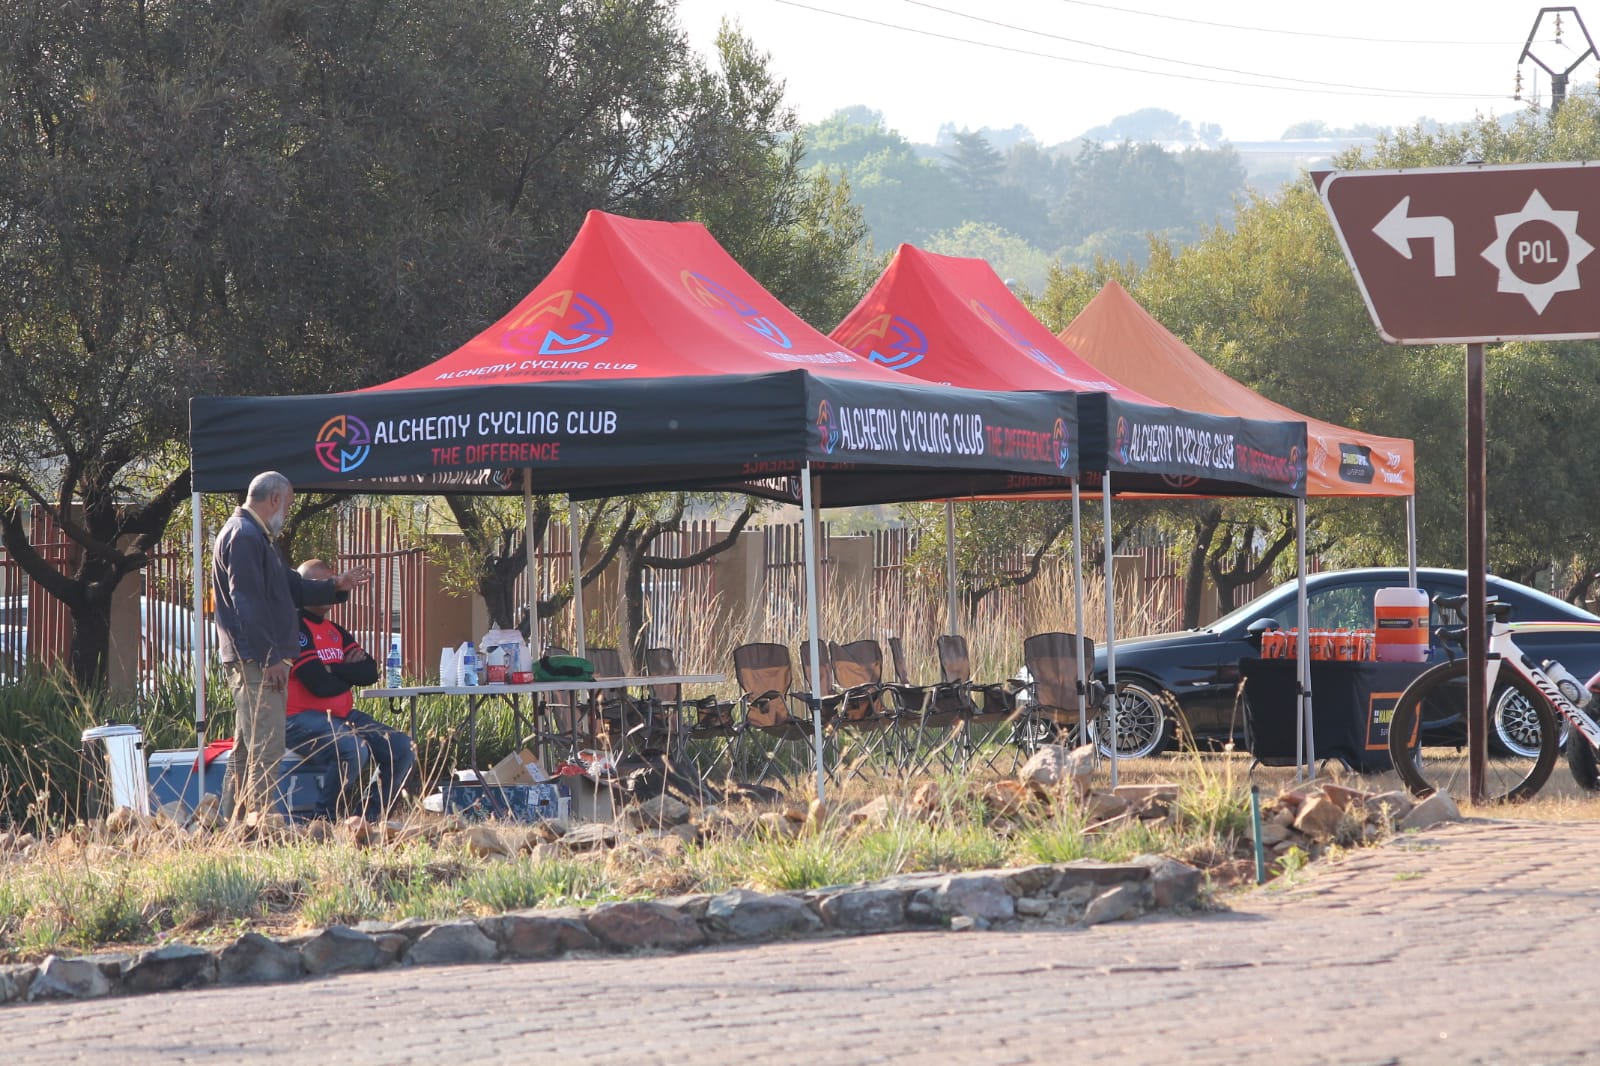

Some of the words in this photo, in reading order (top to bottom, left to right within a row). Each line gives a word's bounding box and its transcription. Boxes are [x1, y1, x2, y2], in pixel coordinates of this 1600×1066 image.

[1518, 240, 1558, 265] POL
[434, 362, 517, 381] ALCHEMY
[520, 360, 589, 369] CYCLING
[593, 362, 638, 371] CLUB
[374, 414, 471, 445] ALCHEMY
[478, 411, 559, 436] CYCLING
[567, 411, 617, 434] CLUB
[840, 406, 898, 451] ALCHEMY
[900, 409, 951, 454] CYCLING
[953, 413, 984, 455] CLUB
[985, 425, 1003, 457] THE
[1005, 427, 1053, 462] DIFFERENCE
[432, 446, 461, 466] THE
[466, 442, 560, 464] DIFFERENCE
[1129, 424, 1172, 463] ALCHEMY
[1175, 425, 1211, 467] CYCLING
[1213, 432, 1235, 469] CLUB
